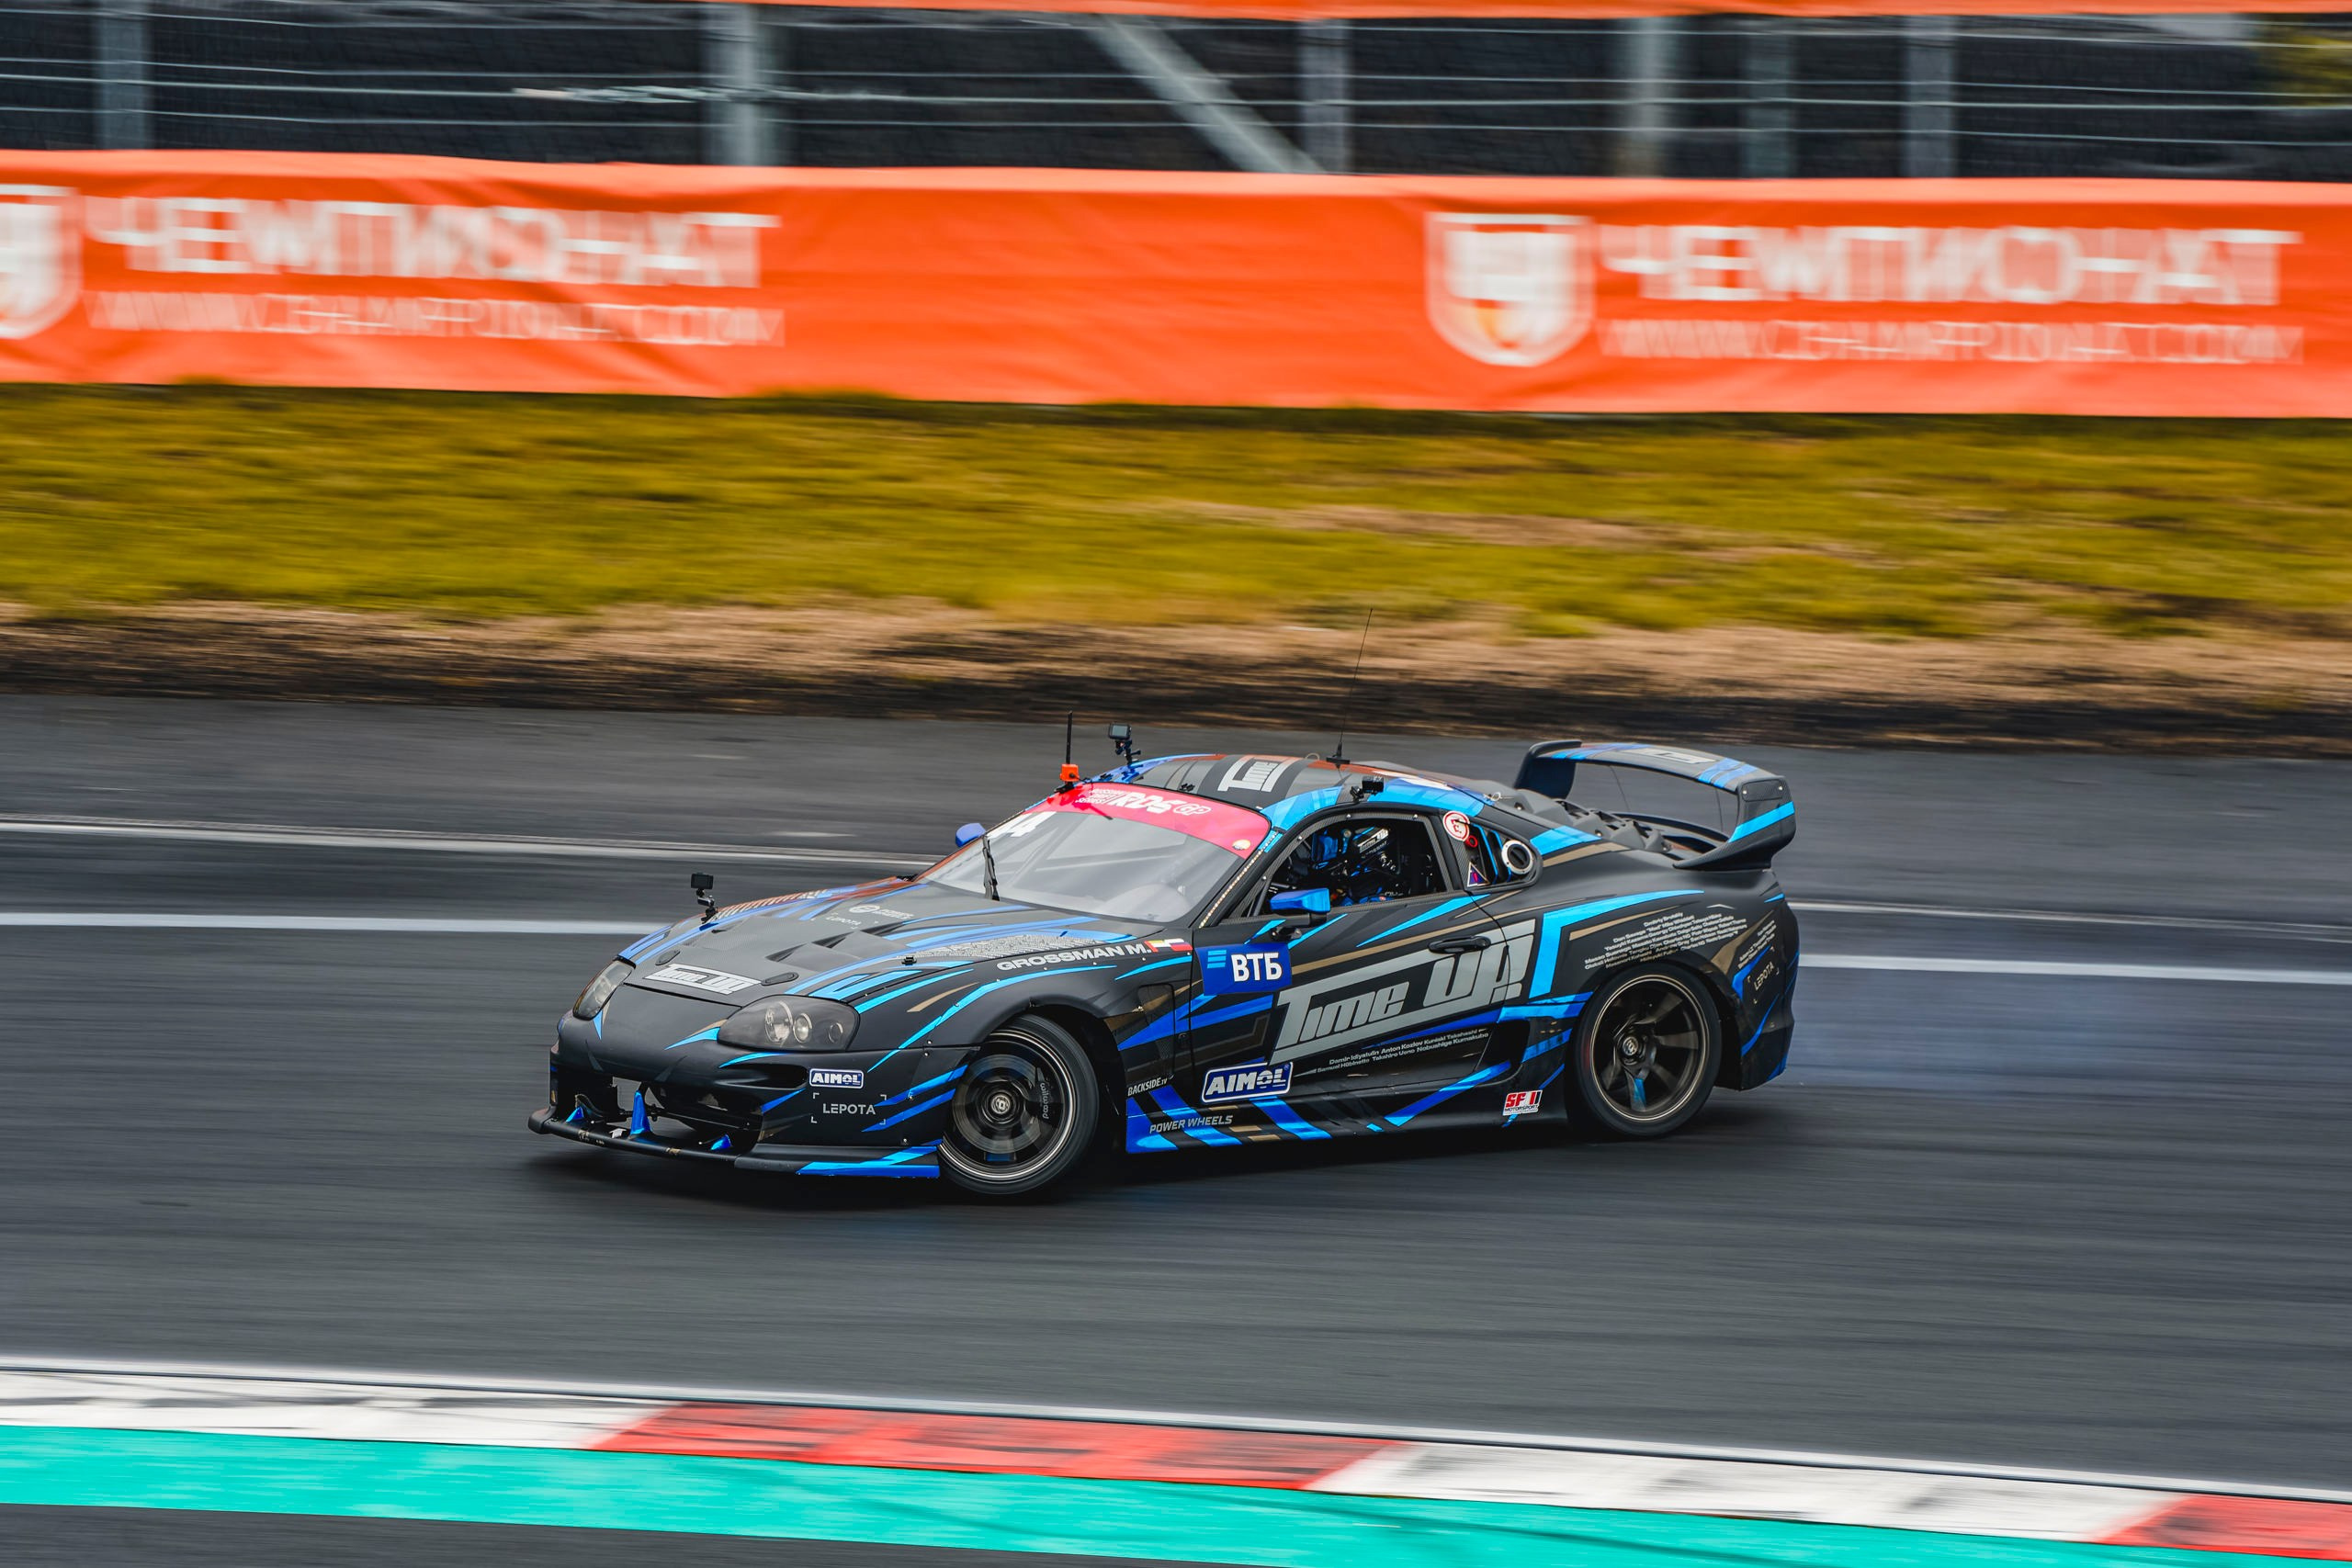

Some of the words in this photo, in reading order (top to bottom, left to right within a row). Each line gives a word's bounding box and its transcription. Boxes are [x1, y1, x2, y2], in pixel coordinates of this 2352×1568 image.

[1108, 792, 1188, 814] RDS
[997, 945, 1125, 971] GROSSMAN
[1231, 952, 1283, 982] ВТБ
[1381, 1045, 1401, 1055] Anton
[1401, 1040, 1424, 1051] Kozlov
[812, 1073, 861, 1085] AIMOL
[1205, 1069, 1286, 1095] AIMOL
[823, 1103, 876, 1114] LEPOTA
[1149, 1119, 1185, 1134] POWER
[1187, 1115, 1234, 1128] WHEELS
